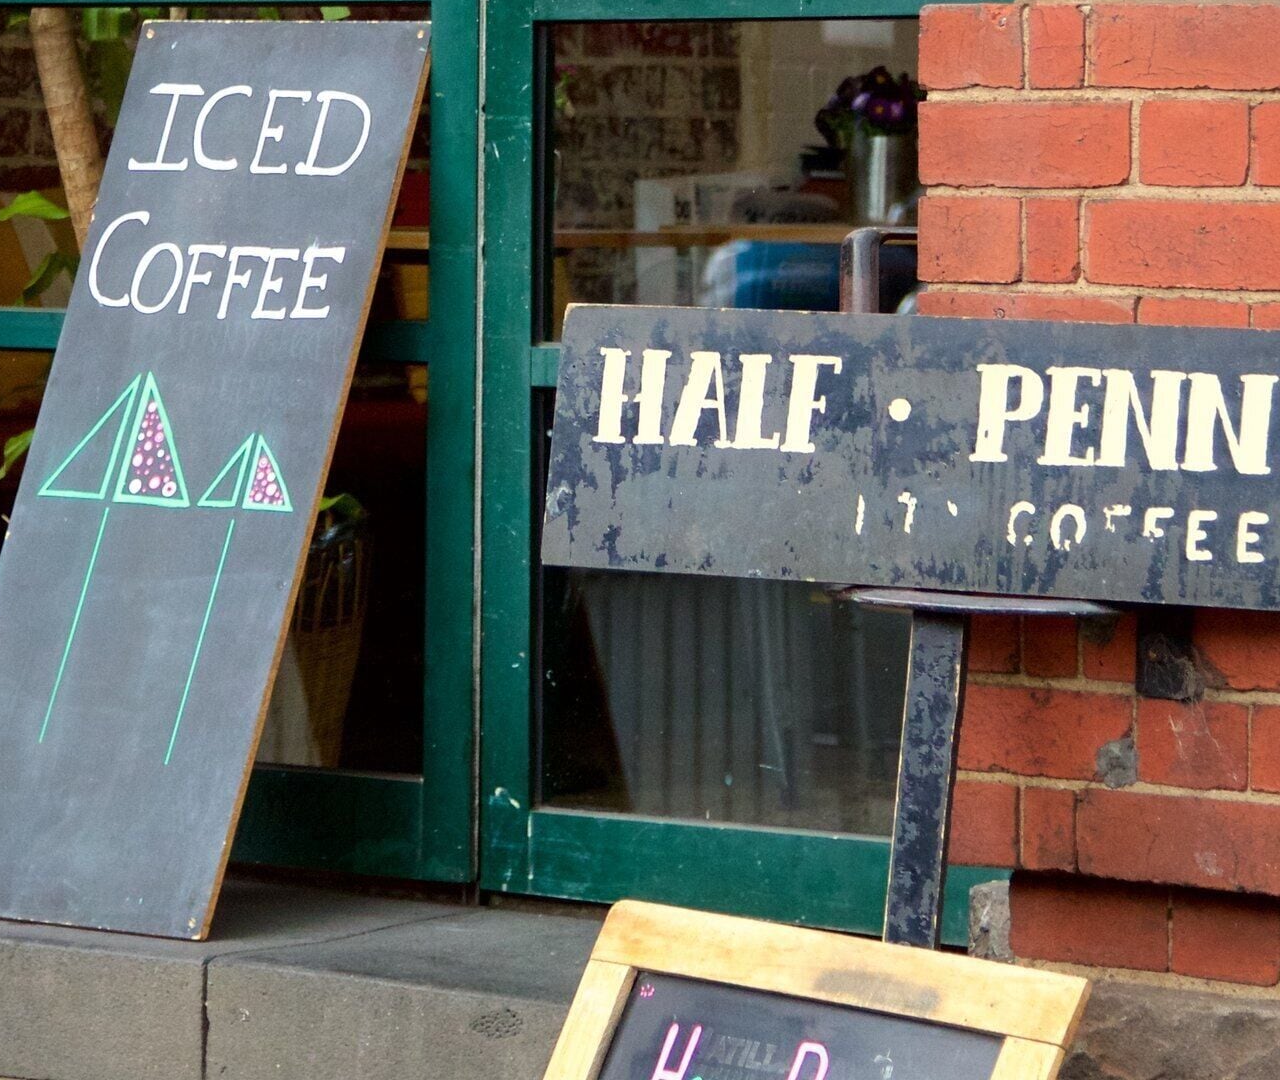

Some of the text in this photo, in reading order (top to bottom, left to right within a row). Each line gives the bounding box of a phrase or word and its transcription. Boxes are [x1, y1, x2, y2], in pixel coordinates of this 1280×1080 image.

[127, 83, 371, 176] ICED
[88, 211, 346, 320] COFFEE
[592, 346, 843, 454] HALF
